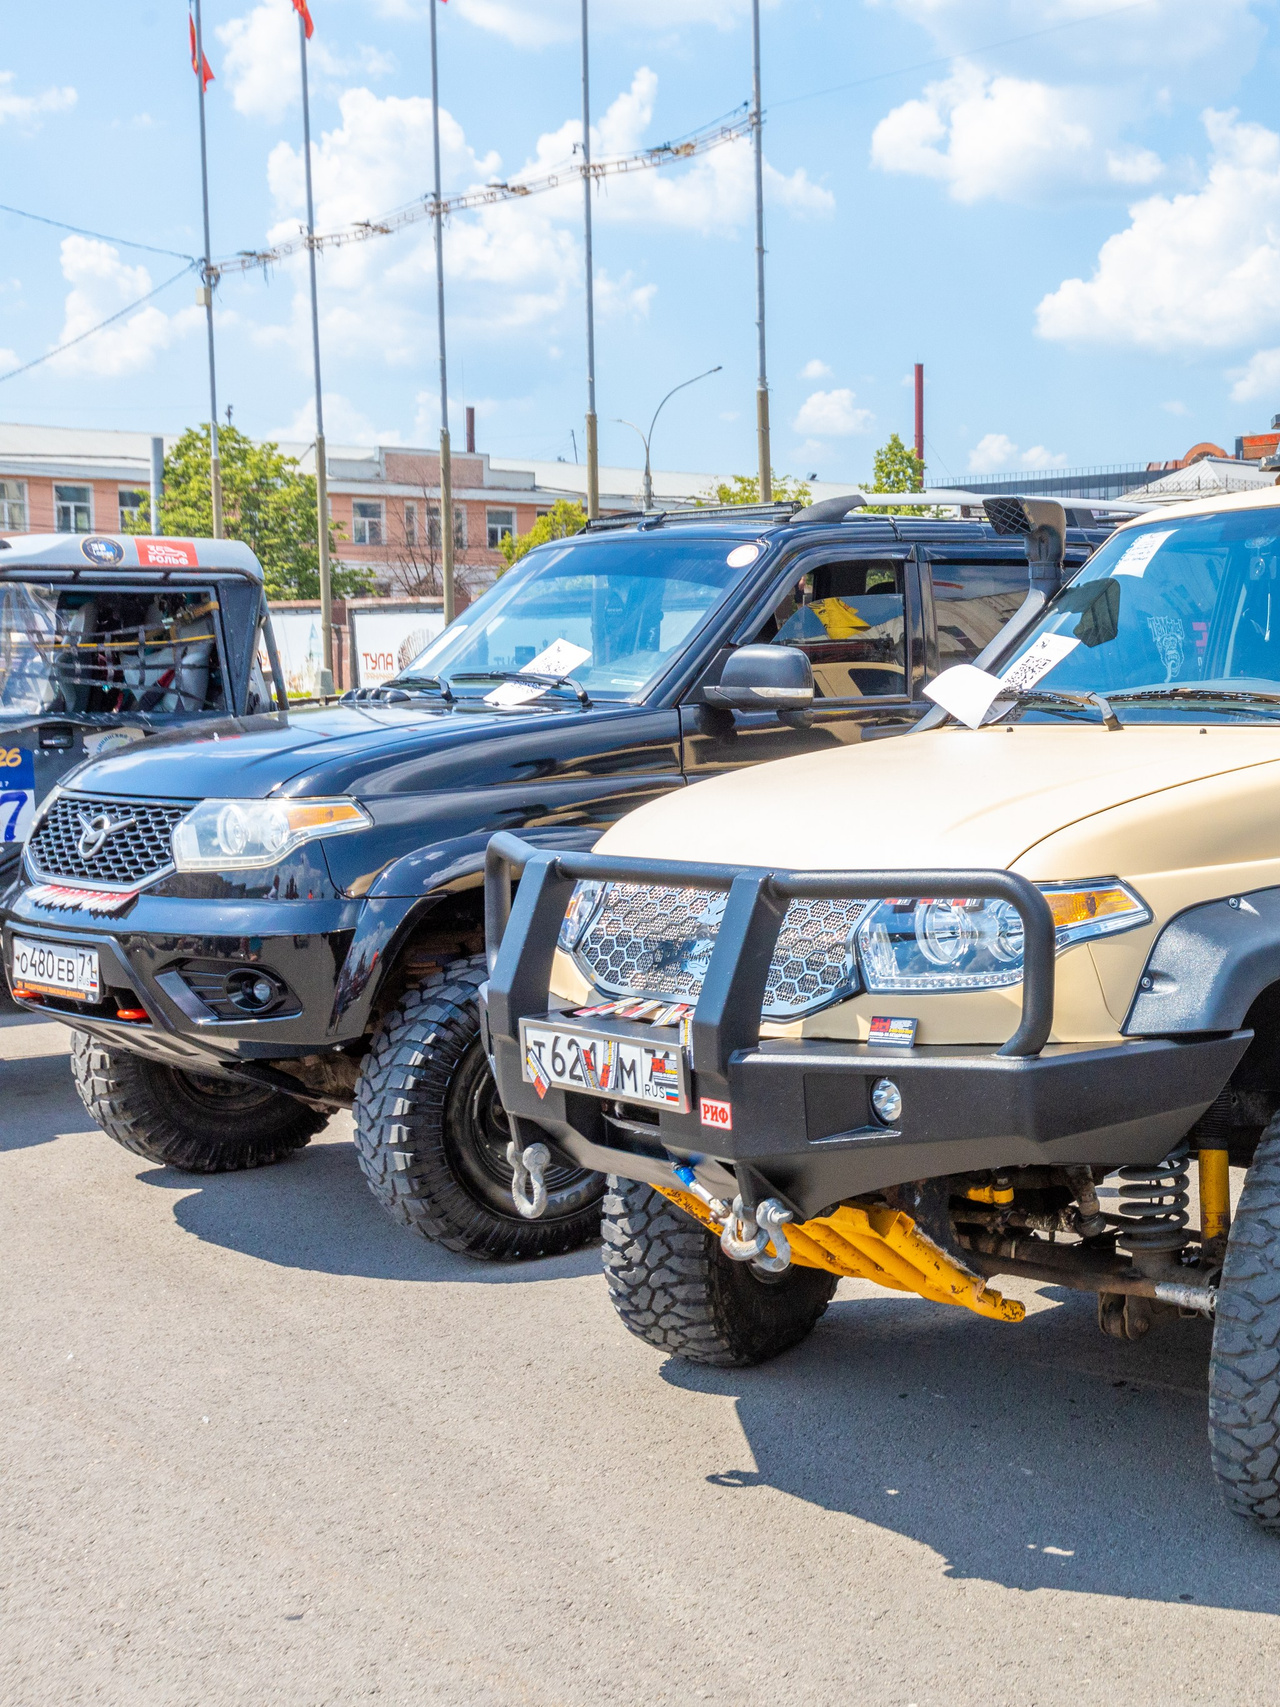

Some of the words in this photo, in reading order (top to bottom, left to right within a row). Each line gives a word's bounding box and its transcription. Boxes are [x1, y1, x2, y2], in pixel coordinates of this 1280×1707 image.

[148, 555, 189, 565] РОЛЬФ
[362, 653, 394, 670] ТУЛА
[78, 953, 94, 979] 71
[644, 1084, 665, 1098] RUS
[702, 1103, 728, 1124] РИФ
